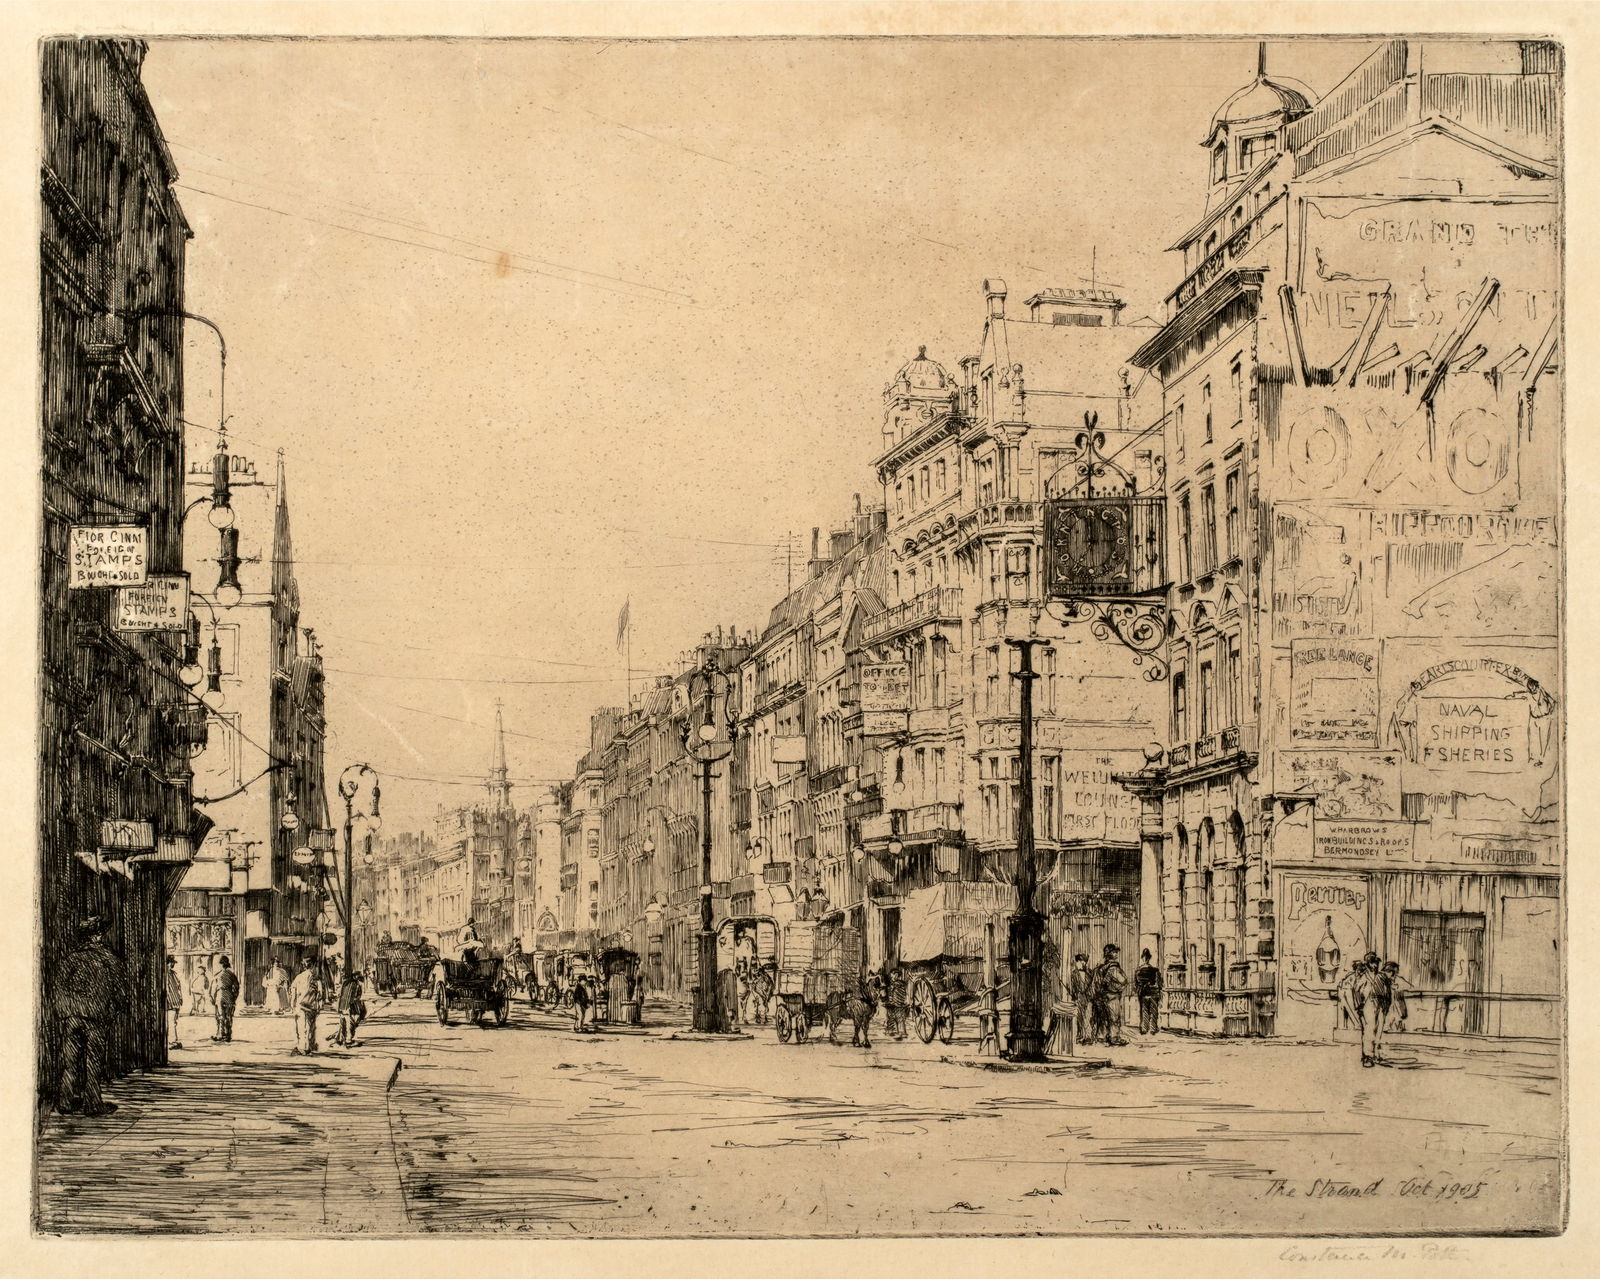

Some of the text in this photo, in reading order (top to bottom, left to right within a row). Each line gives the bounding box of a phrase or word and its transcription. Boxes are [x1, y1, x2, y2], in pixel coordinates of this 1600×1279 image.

[75, 553, 143, 566] STAMPS
[119, 571, 139, 581] SOLD
[1440, 703, 1498, 720] NAVAL
[1431, 725, 1511, 741] SHIPPING
[1265, 1179, 1295, 1198] The
[1306, 1177, 1384, 1199] Strand
